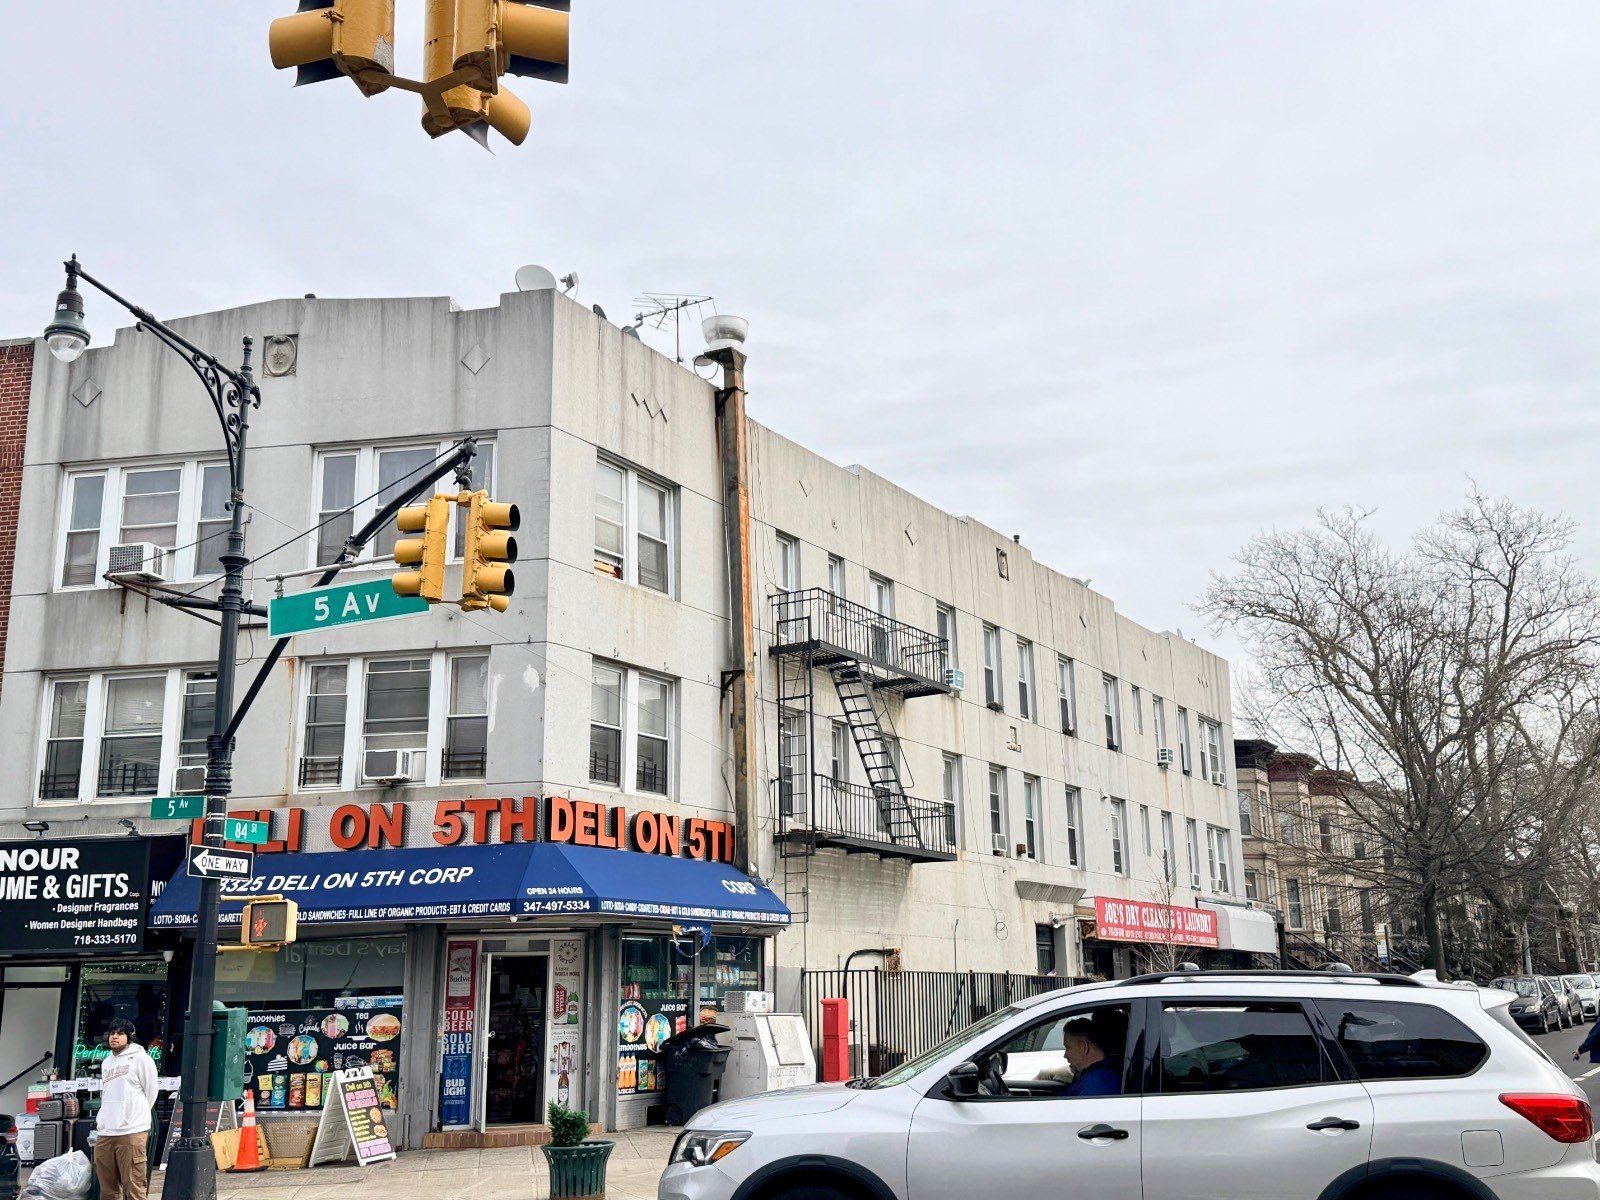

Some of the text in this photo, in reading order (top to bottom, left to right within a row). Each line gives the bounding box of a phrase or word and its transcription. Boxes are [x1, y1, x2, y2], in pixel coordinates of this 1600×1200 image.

[315, 596, 330, 621] 5
[168, 801, 175, 816] 5
[329, 803, 407, 849] ON
[432, 797, 536, 845] 5TH
[548, 797, 626, 849] DELI
[634, 811, 680, 855] ON
[235, 822, 248, 839] 84
[0, 847, 80, 871] NOUR
[202, 856, 244, 871] ONE WAY
[267, 874, 321, 891] DELI
[323, 872, 358, 889] ON
[361, 870, 405, 887] 5TH
[409, 866, 474, 885] CORP
[42, 875, 60, 899] &
[66, 873, 129, 898] GIFTS
[151, 880, 167, 897] NO
[548, 887, 557, 895] 24
[721, 879, 757, 895] CORP
[57, 902, 139, 914] Designer Fragrances
[364, 908, 377, 918] LINE
[378, 908, 386, 917] OF
[387, 907, 414, 917] ORGANIC
[462, 904, 466, 914] &
[467, 903, 489, 913] CREDIT
[490, 902, 510, 912] CARDS
[523, 900, 590, 912] 347-497-5334
[1104, 901, 1124, 924] JOE'S
[1125, 904, 1139, 926] DRY
[1183, 910, 1211, 933] LAUNDRY
[29, 918, 137, 930] Women Designer Handbags
[74, 934, 137, 945] 718-333-5170
[558, 942, 578, 952] STELLA
[450, 975, 470, 983] Budw
[247, 1014, 286, 1023] moothies
[445, 1010, 474, 1020] COLD
[444, 1020, 473, 1031] BEER
[443, 1032, 472, 1044] SOLD
[442, 1043, 472, 1055] HERE
[445, 1079, 465, 1087] BUD
[443, 1087, 466, 1096] LIGHT
